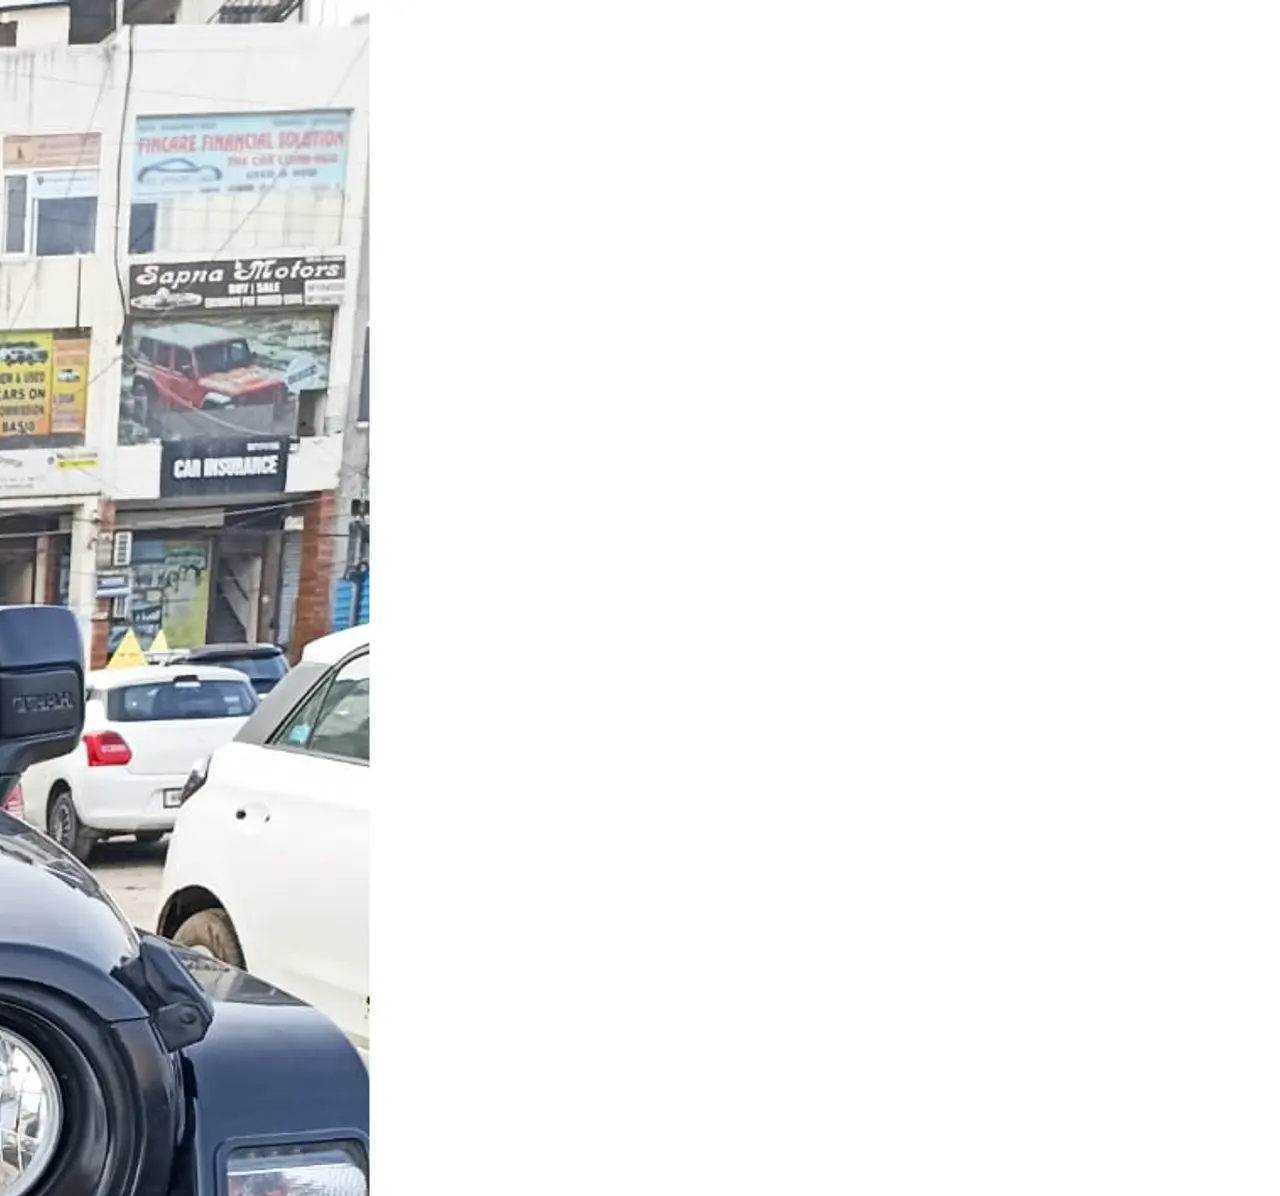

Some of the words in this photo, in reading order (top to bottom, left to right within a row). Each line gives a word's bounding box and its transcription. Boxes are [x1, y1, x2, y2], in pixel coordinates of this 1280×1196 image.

[202, 133, 272, 152] FINANCIAL
[136, 265, 224, 290] Sapna
[233, 258, 340, 280] Motors
[29, 387, 46, 399] ON
[174, 459, 200, 479] CAR
[204, 455, 278, 477] INSURANCE
